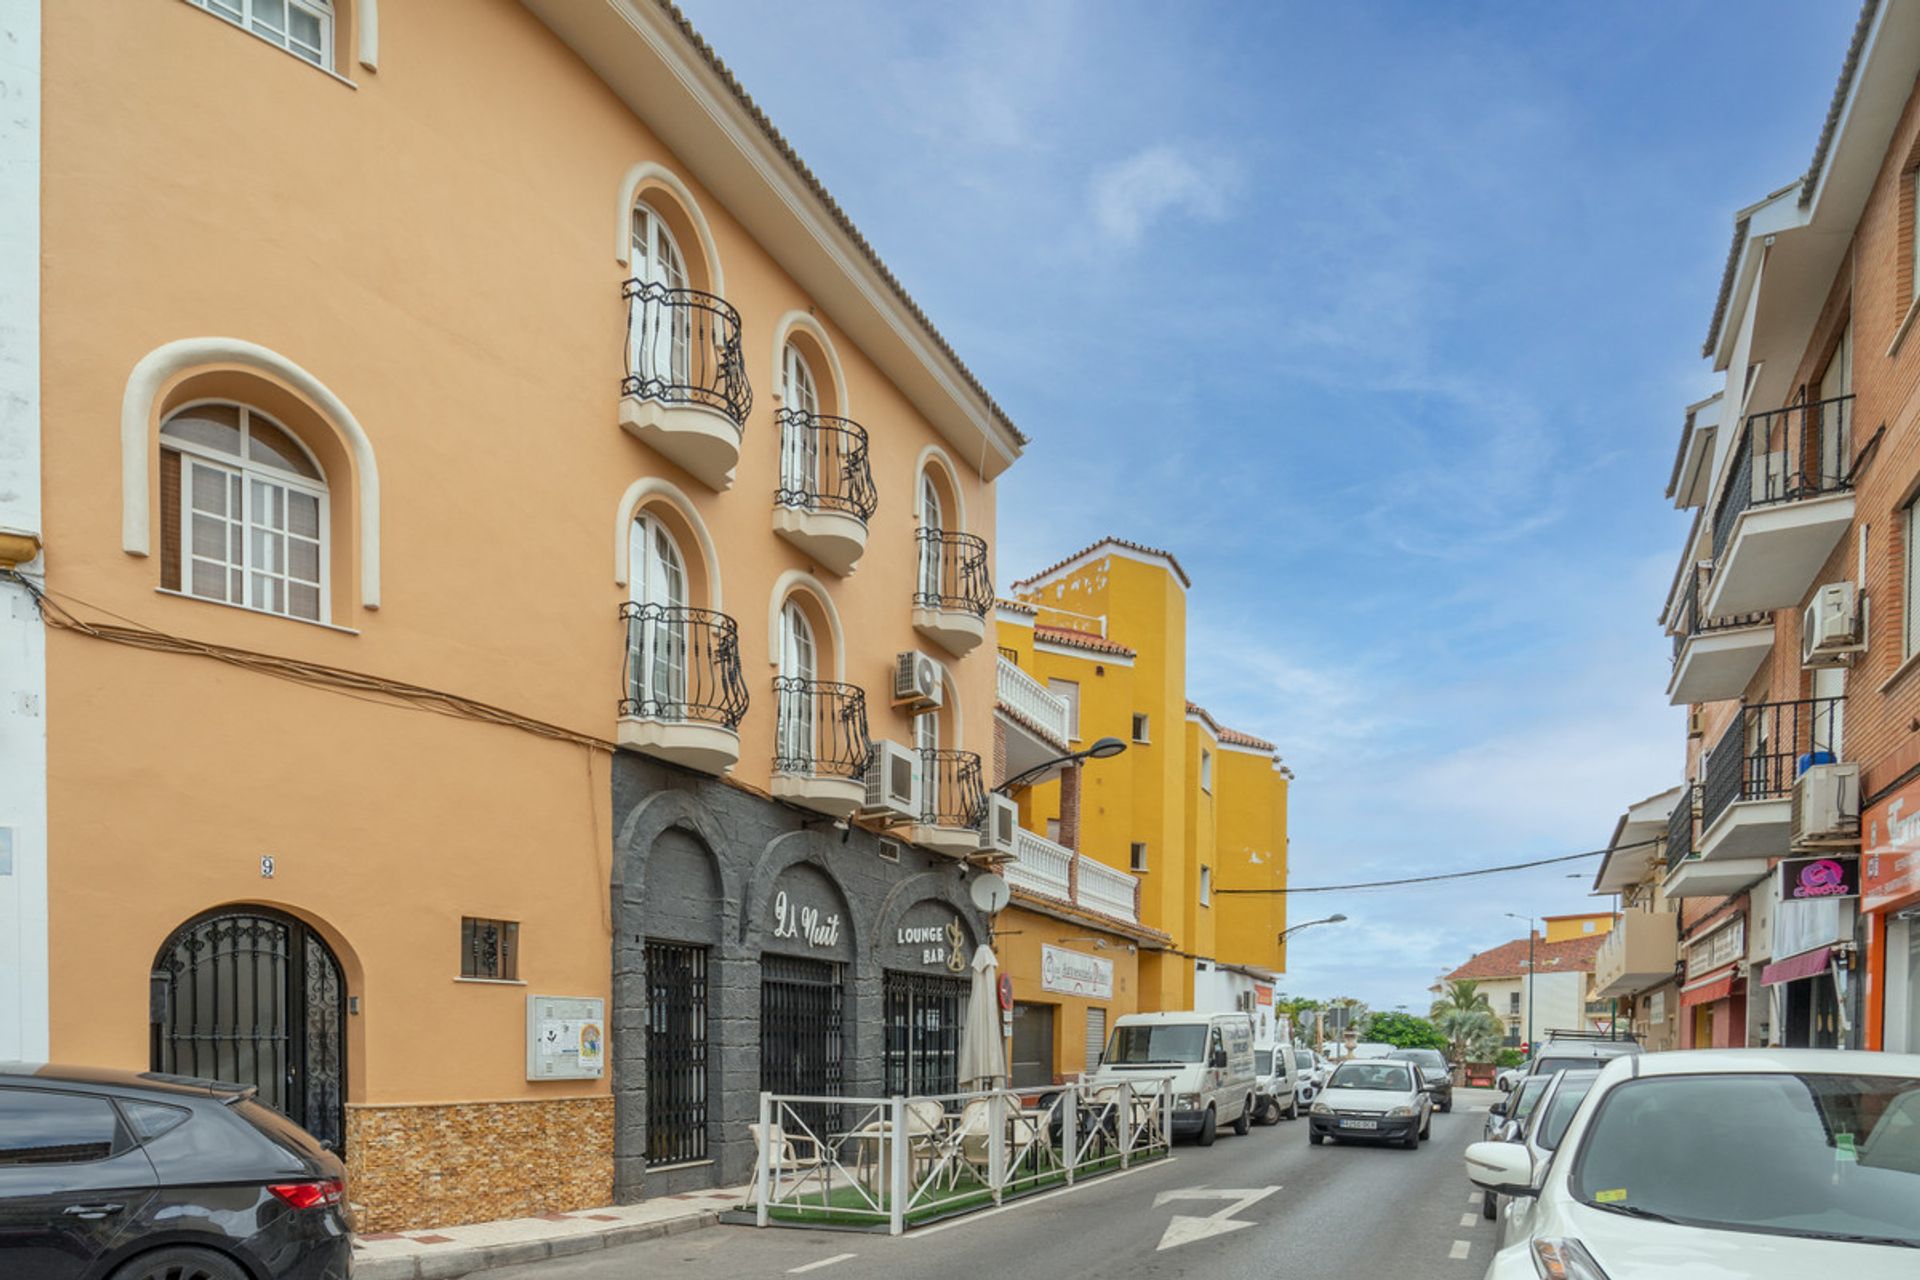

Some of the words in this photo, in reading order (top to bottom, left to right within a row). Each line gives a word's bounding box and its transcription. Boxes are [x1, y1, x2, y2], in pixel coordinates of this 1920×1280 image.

[263, 858, 273, 874] 9
[801, 907, 840, 948] Nuit
[898, 927, 943, 944] LOUNGE
[923, 948, 944, 964] BAR
